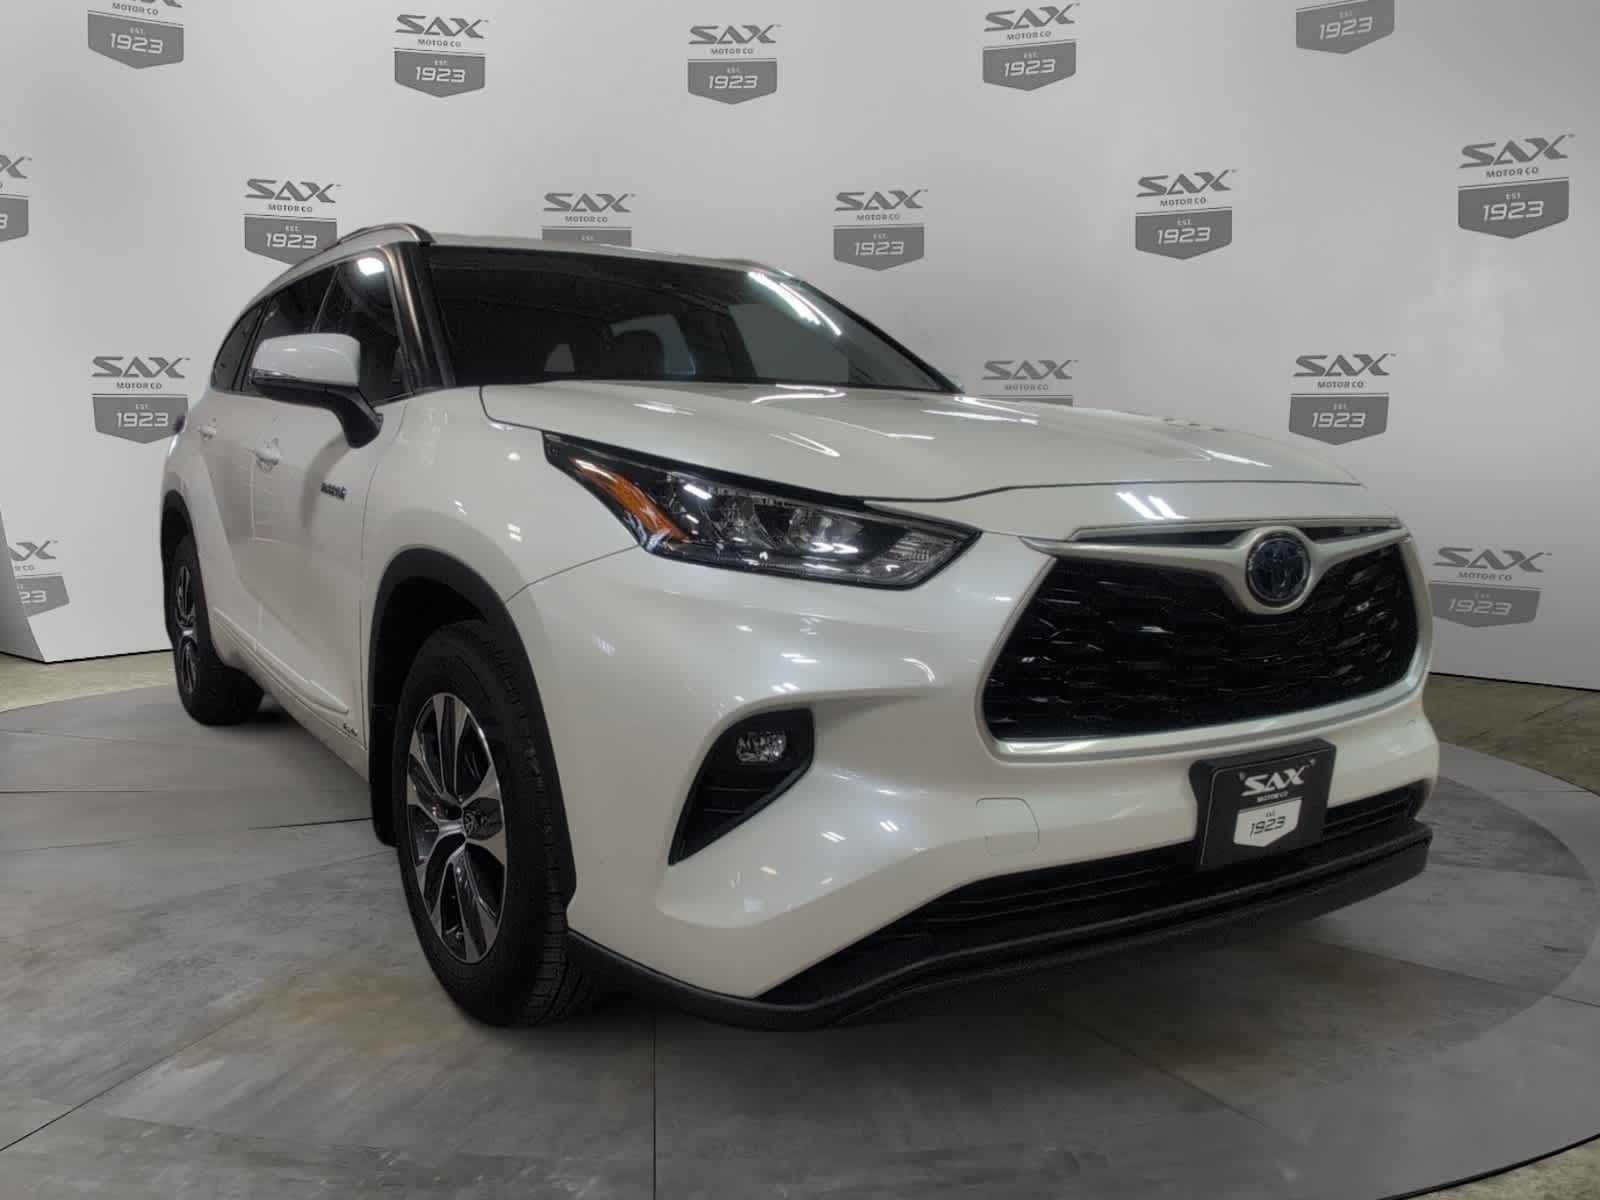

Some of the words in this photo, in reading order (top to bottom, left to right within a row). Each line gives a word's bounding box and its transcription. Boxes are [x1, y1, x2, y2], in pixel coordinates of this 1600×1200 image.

[395, 14, 484, 39] SAX
[984, 4, 1075, 32] SAX
[1319, 16, 1373, 40] 1923
[109, 32, 163, 54] 1923
[688, 25, 776, 45] SAX
[416, 66, 465, 83] 1923
[1004, 59, 1056, 77] 1923
[709, 75, 758, 89] 1923
[1459, 134, 1568, 168] SAX
[1485, 168, 1523, 178] MOTOR
[1525, 166, 1539, 175] CO
[245, 179, 336, 203] SAX
[1136, 169, 1231, 197] SAX
[543, 193, 632, 212] SAX
[834, 189, 924, 211] SAX
[1160, 198, 1192, 206] MOTOR
[1194, 197, 1207, 205] CO
[1482, 200, 1544, 221] 1923
[266, 233, 317, 248] 1923
[1157, 227, 1211, 245] 1923
[855, 241, 904, 256] 1923
[91, 356, 186, 378] SAX
[982, 360, 1072, 380] SAX
[1293, 353, 1390, 376] SAX
[116, 412, 168, 427] 1923
[1312, 412, 1366, 428] 1923
[1432, 546, 1544, 573] SAX
[1448, 597, 1512, 616] 1923
[1241, 765, 1305, 797] SAX
[1250, 815, 1286, 836] 1923
